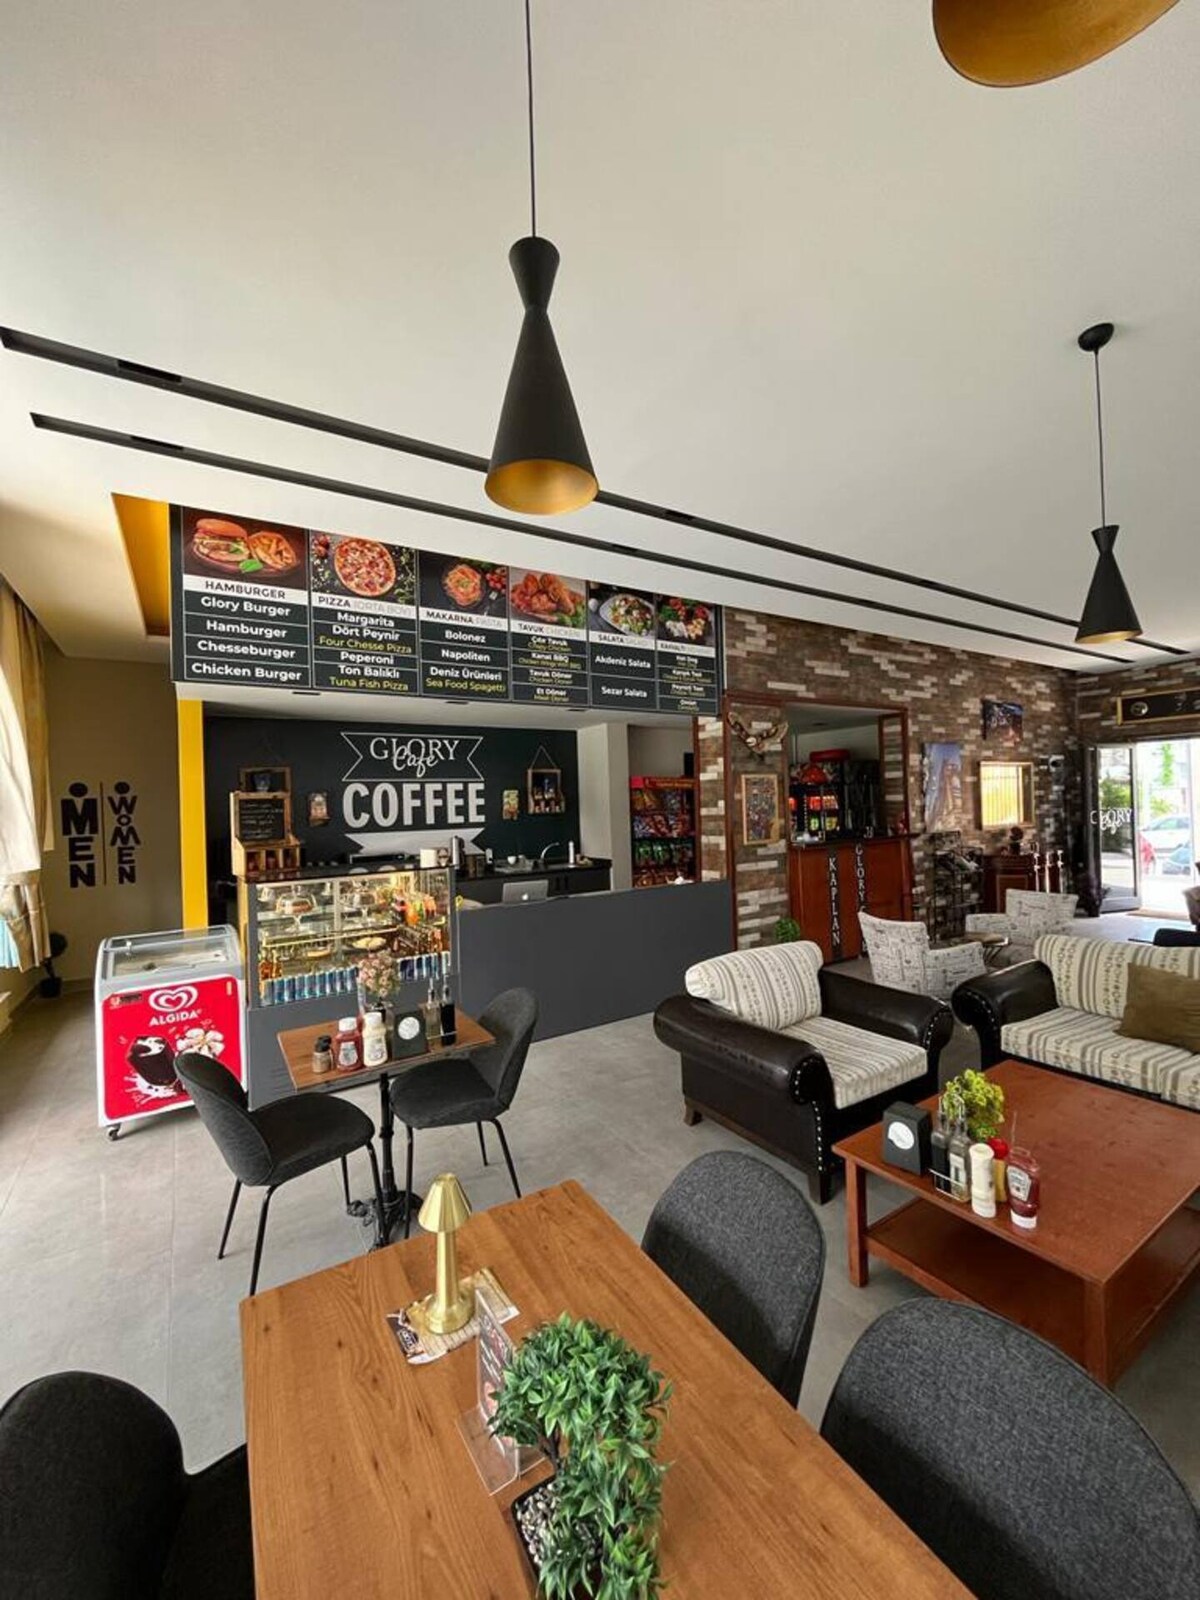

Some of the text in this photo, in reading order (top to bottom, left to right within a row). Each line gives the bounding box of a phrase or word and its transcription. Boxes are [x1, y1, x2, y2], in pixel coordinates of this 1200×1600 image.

[205, 580, 286, 599] HAMBURGER
[200, 596, 291, 617] Glory Burger
[318, 596, 351, 608] PIZZA
[337, 612, 395, 627] Margarita
[426, 611, 474, 624] MAKARNA
[206, 619, 288, 639] Hamburger
[332, 624, 400, 642] Dört Peynir
[518, 623, 545, 634] TAVUK
[444, 630, 486, 643] Bolonez
[598, 633, 624, 643] SALATA
[197, 640, 296, 659] Chesseburger
[319, 635, 412, 654] Four Chesse Pizza
[340, 651, 394, 665] Peperoni
[441, 648, 491, 662] Napoliten
[595, 655, 651, 669] Akdeniz Salata
[191, 662, 302, 682] Chicken Burger
[338, 665, 361, 676] Ton
[430, 666, 502, 681] Deniz Ürünleri
[328, 676, 409, 691] Tuna Fish Pizza
[425, 677, 443, 688] Sea
[445, 679, 468, 690] Food
[601, 685, 648, 698] Sezar Salata
[369, 737, 460, 761] GLORY
[392, 745, 439, 778] Cafe
[342, 782, 486, 828] COFFEE
[61, 797, 99, 889] MEN
[855, 844, 866, 901] GLORY
[829, 857, 840, 947] KAPLAN
[149, 1010, 199, 1026] ALGIDA
